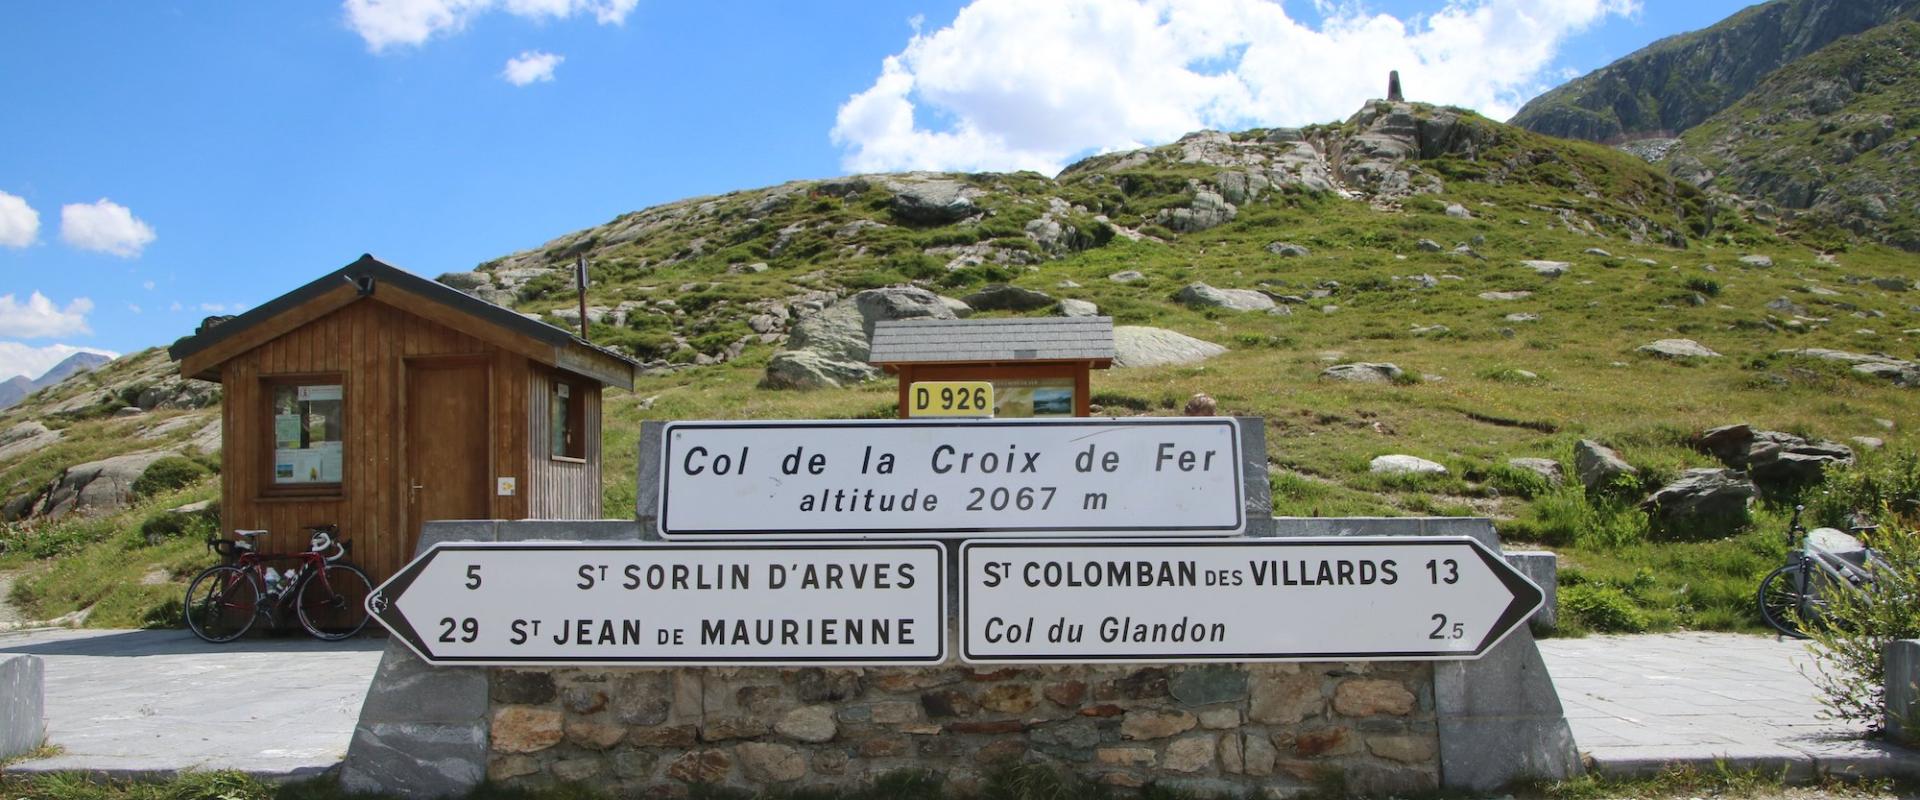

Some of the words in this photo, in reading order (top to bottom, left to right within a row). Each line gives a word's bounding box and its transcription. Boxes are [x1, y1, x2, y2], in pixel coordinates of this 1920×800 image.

[915, 387, 931, 411] D
[940, 387, 988, 411] 926
[682, 444, 750, 477] Col
[781, 444, 828, 477] de
[860, 443, 897, 476] la
[931, 443, 1042, 475] Croix
[1075, 442, 1121, 474] de
[1155, 441, 1217, 473] Fer
[798, 487, 939, 514] altitude
[966, 486, 1058, 512] 2067
[1083, 492, 1109, 511] m
[464, 563, 483, 592] 5
[621, 562, 751, 592] SORLIN
[768, 562, 916, 591] D'ARVES
[1022, 559, 1198, 589] COLOMBAN
[1205, 568, 1244, 588] DES
[1249, 558, 1399, 588] VILLARDS
[1425, 557, 1461, 586] 13
[438, 616, 480, 645] 29
[552, 618, 642, 647] JEAN
[657, 627, 685, 647] DE
[700, 617, 916, 647] MAURIENNE
[983, 615, 1035, 645] Col
[1047, 615, 1085, 645] du
[1098, 615, 1227, 645] Glandon
[1427, 612, 1465, 641] 2.5
